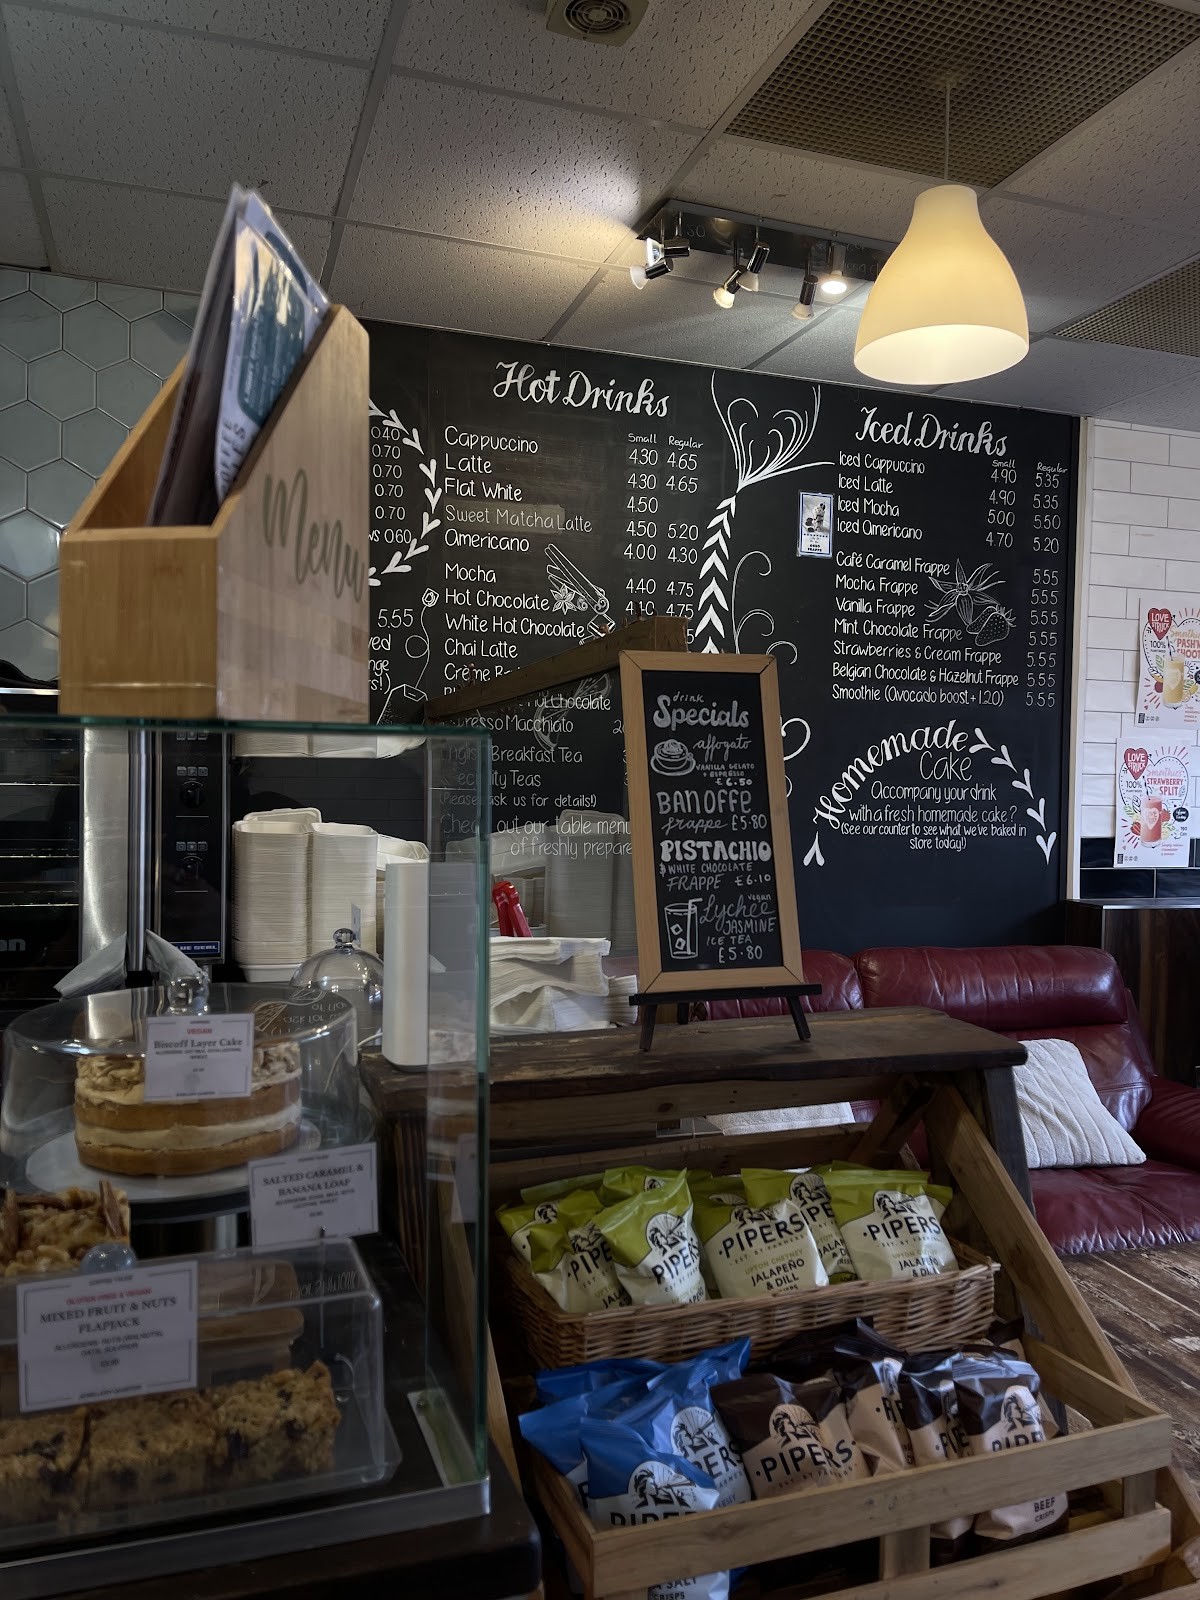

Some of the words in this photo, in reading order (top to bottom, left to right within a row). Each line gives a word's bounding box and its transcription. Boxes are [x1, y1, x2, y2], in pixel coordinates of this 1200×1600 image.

[493, 361, 560, 404] Hot
[562, 370, 670, 418] Drinks
[444, 425, 538, 454] Cappuccino
[855, 406, 913, 446] Iced
[914, 413, 1008, 457] Drinks
[372, 444, 400, 459] 0.70
[628, 433, 657, 444] Small
[668, 435, 703, 451] Regular
[445, 453, 492, 474] Latte
[629, 448, 658, 466] 4.30
[667, 452, 698, 471] 4.65
[839, 450, 860, 467] Iced
[864, 453, 925, 475] Cappuccino
[1037, 462, 1068, 474] Regular
[373, 464, 402, 479] 0.70
[445, 477, 476, 497] Flat
[482, 482, 523, 502] White
[627, 473, 657, 490] 4.30
[665, 475, 698, 493] 4.65
[838, 473, 859, 490] Iced
[864, 475, 894, 494] Latte
[627, 495, 658, 513] 4.50
[837, 496, 859, 514] Iced
[863, 498, 900, 517] Mocha
[989, 489, 1015, 506] 4.90
[445, 504, 490, 524] Sweet
[497, 508, 554, 530] Matcha
[557, 514, 593, 533] Latte
[837, 517, 859, 535] Iced
[862, 519, 922, 540] Americano
[263, 468, 365, 603] Menu
[445, 528, 530, 551] Americano
[626, 520, 657, 538] 4.50
[667, 523, 698, 541] 5.20
[986, 532, 1013, 549] 4.70
[1033, 536, 1059, 554] 5.20
[624, 543, 656, 561] 4.00
[667, 547, 698, 564] 4.30
[836, 551, 863, 568] Café
[866, 554, 911, 572] Caramel
[915, 558, 950, 576] Frappe
[445, 563, 496, 583] Mocha
[626, 578, 656, 595] 4.40
[667, 581, 694, 597] 4.75
[835, 574, 875, 591] Mocha
[880, 577, 918, 596] Frappe
[445, 588, 471, 606] Hot
[476, 589, 550, 612] Chocolate
[836, 597, 872, 614] Vanilla
[876, 599, 915, 617] Frappe
[377, 609, 414, 629] 5.55
[445, 613, 488, 633] White
[493, 616, 517, 635] Hot
[521, 617, 585, 638] Chocolate
[1151, 612, 1170, 623] LOVE
[834, 618, 858, 635] Mint
[863, 620, 919, 638] Chocolate
[924, 624, 962, 642] Frappe
[445, 638, 477, 657] Chai
[481, 640, 518, 659] Latte
[834, 640, 911, 659] Strawberries
[924, 646, 961, 662] Cream
[965, 648, 1001, 666] Frappe
[1150, 640, 1166, 649] 100%
[833, 662, 871, 681] Belgian
[875, 664, 927, 682] Chocolate
[939, 669, 983, 685] Hazelnut
[986, 670, 1019, 688] Frappe
[672, 691, 704, 703] drink
[832, 684, 881, 701] Smoothie
[940, 689, 970, 705] boost
[653, 694, 749, 731] Specials
[506, 715, 574, 733] Macchiato
[491, 745, 556, 763] Breakfast
[558, 747, 583, 763] Tea
[693, 733, 752, 762] affogato
[696, 763, 726, 771] VANILLA
[919, 750, 972, 781] Cake
[1127, 753, 1146, 763] LOVE
[510, 770, 541, 788] Teas
[812, 719, 969, 830] Homemade
[1126, 780, 1142, 789] 100%
[1147, 778, 1184, 786] STRAWBERRY
[513, 796, 527, 807] us
[531, 794, 549, 807] for
[871, 780, 942, 804] Accompany
[944, 786, 970, 804] your
[970, 783, 997, 801] drink
[1159, 786, 1179, 796] SPLIT
[849, 804, 872, 822] with
[874, 810, 882, 822] a
[884, 805, 914, 822] fresh
[917, 805, 977, 823] homemade
[497, 816, 521, 834] out
[524, 820, 549, 834] our
[555, 815, 592, 835] table
[660, 816, 728, 836] frappe
[863, 826, 878, 835] our
[878, 824, 910, 835] counter
[912, 825, 921, 835] to
[923, 826, 938, 836] see
[939, 824, 961, 836] what
[991, 825, 1017, 837] baked
[1018, 826, 1027, 837] in
[511, 836, 528, 856] of
[530, 836, 578, 860] freshly
[660, 840, 772, 862] PISTACHIO
[909, 837, 932, 850] store
[668, 863, 696, 875] WHITE
[701, 862, 753, 874] CHOCOLATE
[667, 873, 725, 892] FRAPPE
[747, 893, 772, 903] vegan
[700, 894, 776, 932] Lychee
[722, 917, 777, 935] JASMINE
[730, 935, 752, 945] TEA
[263, 1173, 304, 1186] SALTED
[278, 1183, 322, 1197] BANANA
[721, 1213, 805, 1259] PIPERS
[866, 1215, 941, 1241] PIPERS
[751, 1258, 805, 1287] JALAPEÑO
[775, 1273, 799, 1288] DILL
[40, 1309, 84, 1325] MIXED
[88, 1302, 126, 1317] FRUIT
[142, 1296, 177, 1311] NUTS
[79, 1317, 140, 1334] FLAPJACK
[760, 1438, 852, 1482] PIPERS
[1033, 1497, 1056, 1512] BEEF
